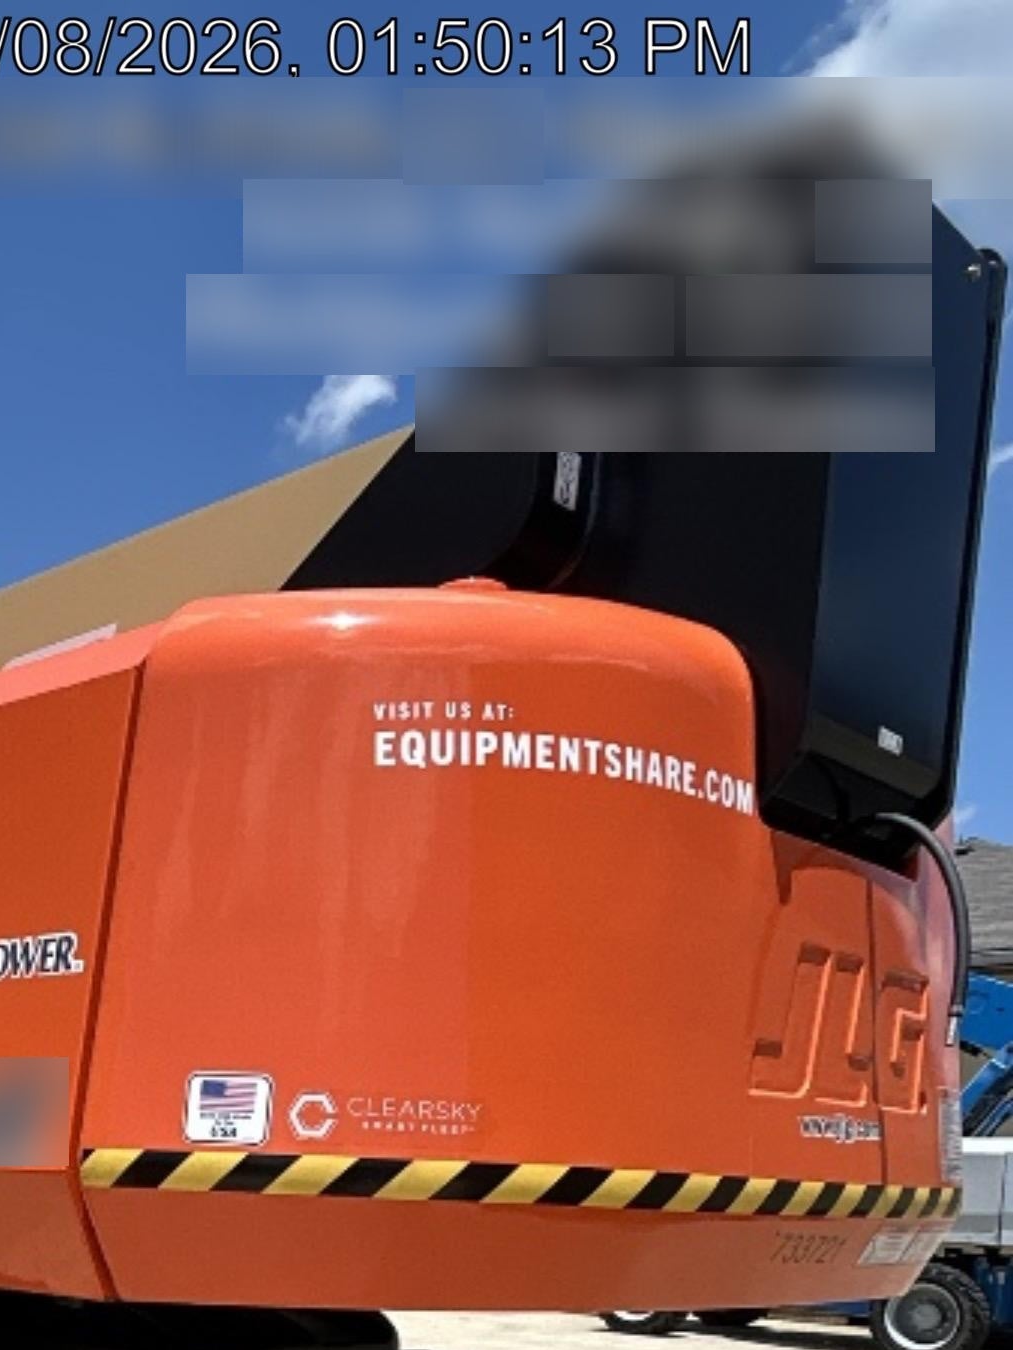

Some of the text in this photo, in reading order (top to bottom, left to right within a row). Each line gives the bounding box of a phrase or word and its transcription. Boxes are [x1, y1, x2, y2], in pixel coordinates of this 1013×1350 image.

[374, 701, 515, 721] VISIT US AT:
[374, 729, 754, 817] EQUIPMENTSHARE.COM
[346, 1097, 483, 1122] CLEARSKY
